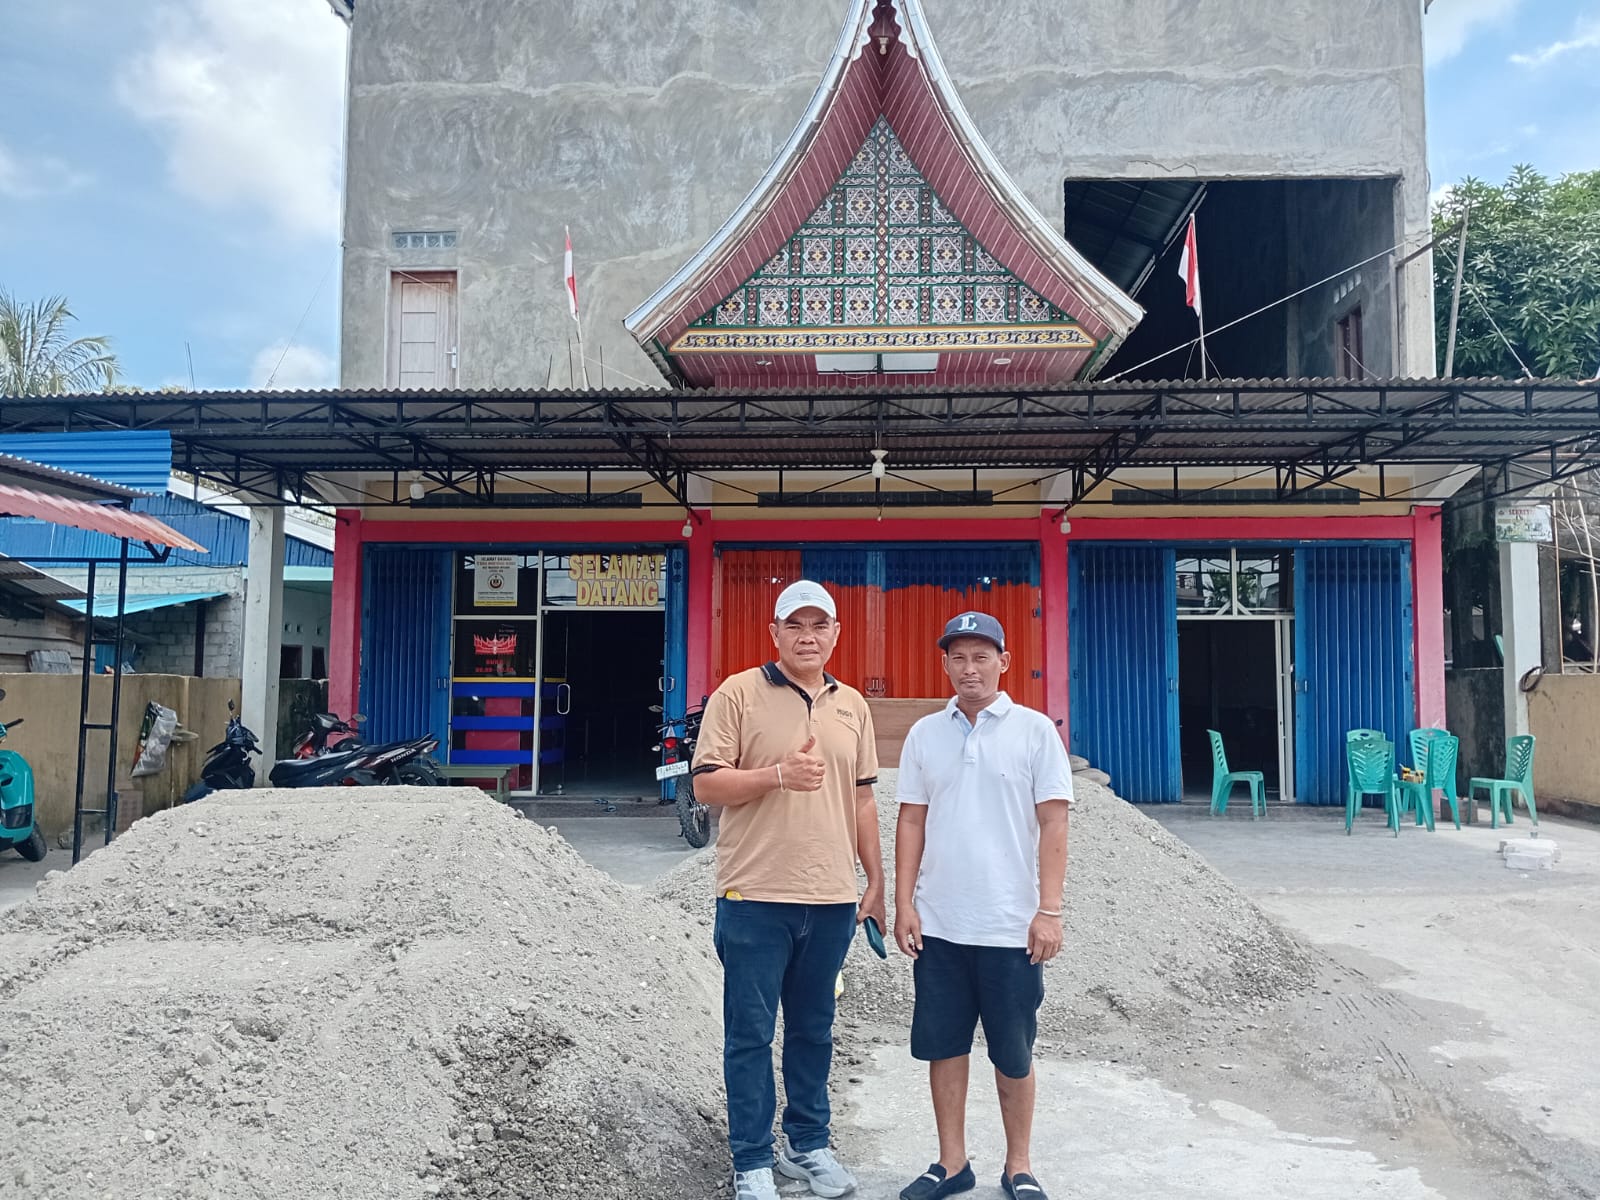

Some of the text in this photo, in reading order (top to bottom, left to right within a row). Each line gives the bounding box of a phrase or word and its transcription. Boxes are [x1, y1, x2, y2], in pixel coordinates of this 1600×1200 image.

[568, 554, 665, 580] SELAMAT
[576, 580, 659, 606] DATANG
[958, 614, 977, 631] L
[390, 748, 417, 763] HONDA
